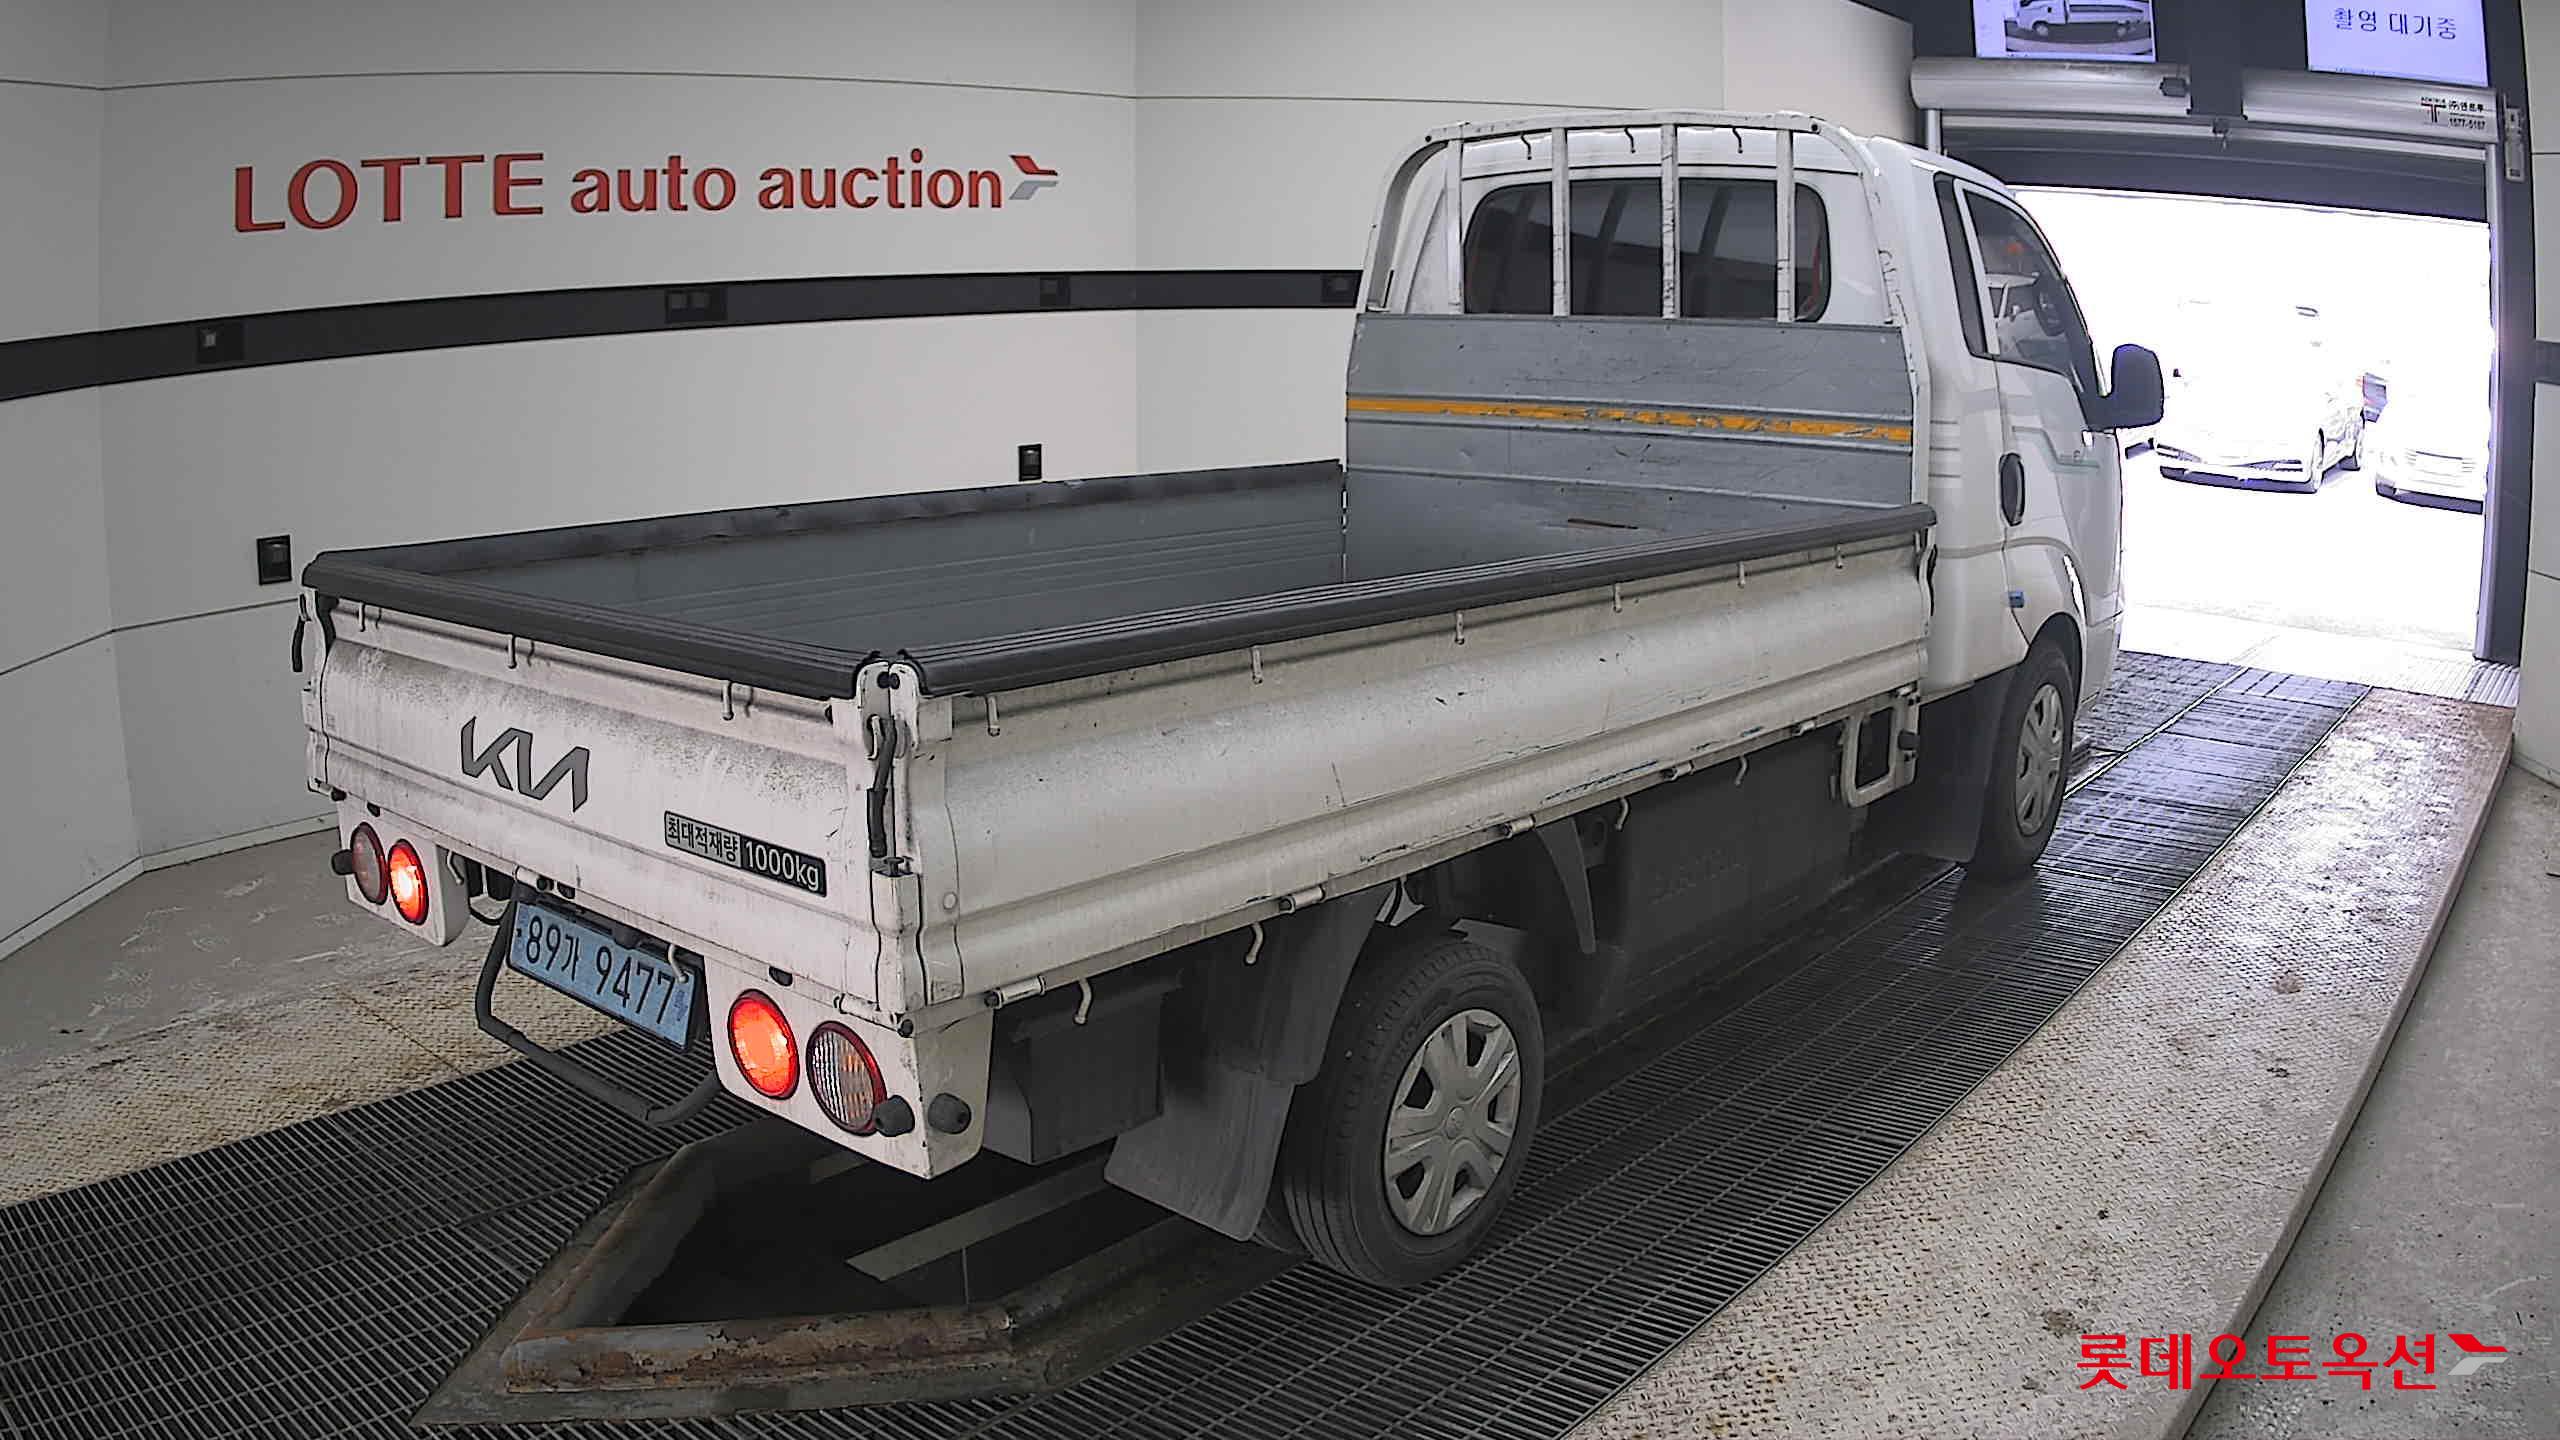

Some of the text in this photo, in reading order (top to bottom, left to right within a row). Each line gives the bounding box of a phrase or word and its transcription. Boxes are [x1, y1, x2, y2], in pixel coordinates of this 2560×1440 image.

[2334, 7, 2457, 40] 촬영 대기중
[234, 147, 1003, 233] LOTTE auto auction
[667, 816, 820, 892] 최대적재량 1000kg
[526, 915, 676, 1025] 89가 9477
